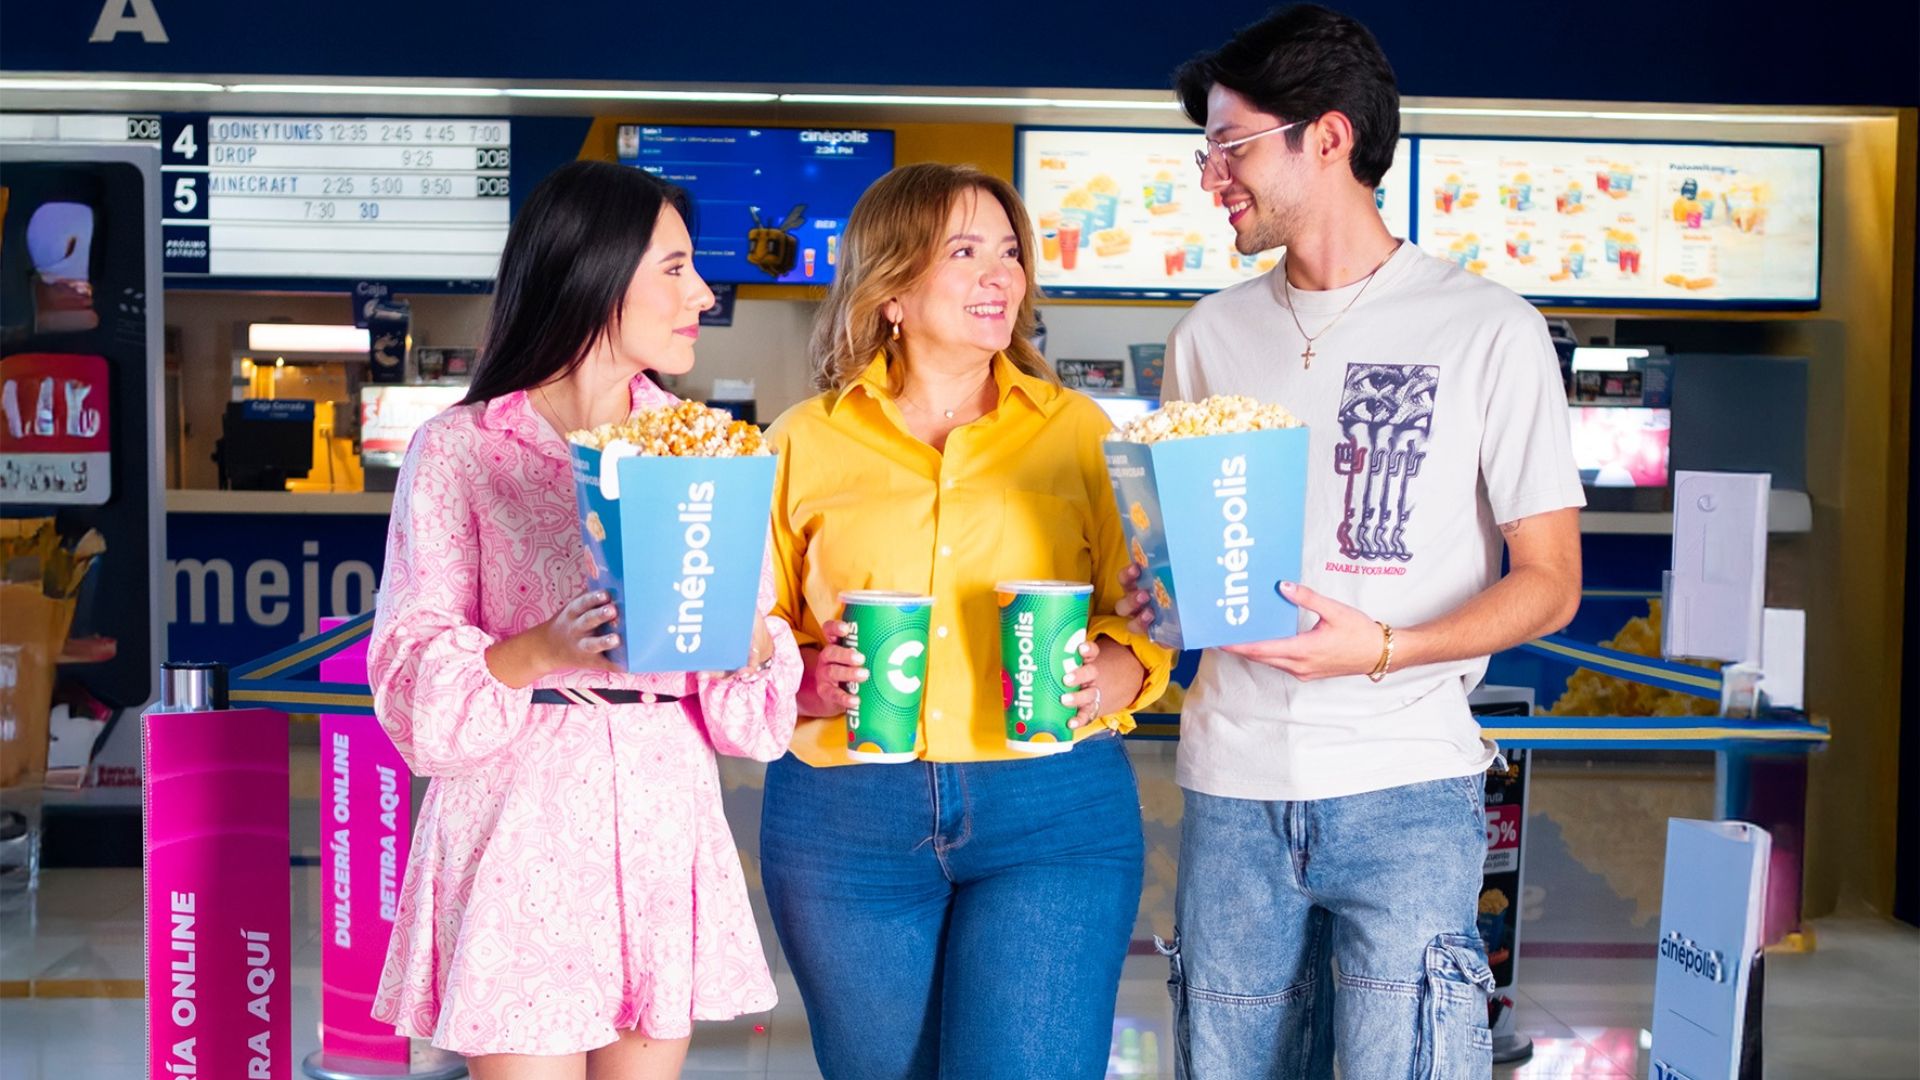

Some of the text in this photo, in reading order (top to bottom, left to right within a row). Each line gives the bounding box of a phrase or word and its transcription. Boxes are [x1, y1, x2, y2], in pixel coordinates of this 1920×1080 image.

[88, 0, 170, 43] A
[128, 119, 161, 139] DOB
[172, 124, 198, 159] 4
[330, 124, 367, 141] 12:35
[381, 124, 413, 141] 2:45
[424, 125, 455, 142] 4:45
[469, 126, 501, 142] 7:00
[214, 146, 510, 168] DROP 9:25 DOB
[173, 177, 198, 213] 5
[208, 175, 510, 196] MINECRAFT 2:25 5:00 9:50 DOB
[304, 201, 380, 219] 7:30 3D
[356, 281, 388, 297] Caja
[1212, 455, 1254, 626] cinépolis
[667, 480, 715, 654] cinépolis
[1325, 562, 1360, 574] ENABLE
[1015, 612, 1038, 721] cinépolis
[330, 732, 351, 949] DULCERÍA ONLINE
[376, 764, 400, 923] RETIRA AQUÍ
[166, 891, 197, 1080] ÍA ONLINE
[240, 928, 276, 1022] AQUÍ
